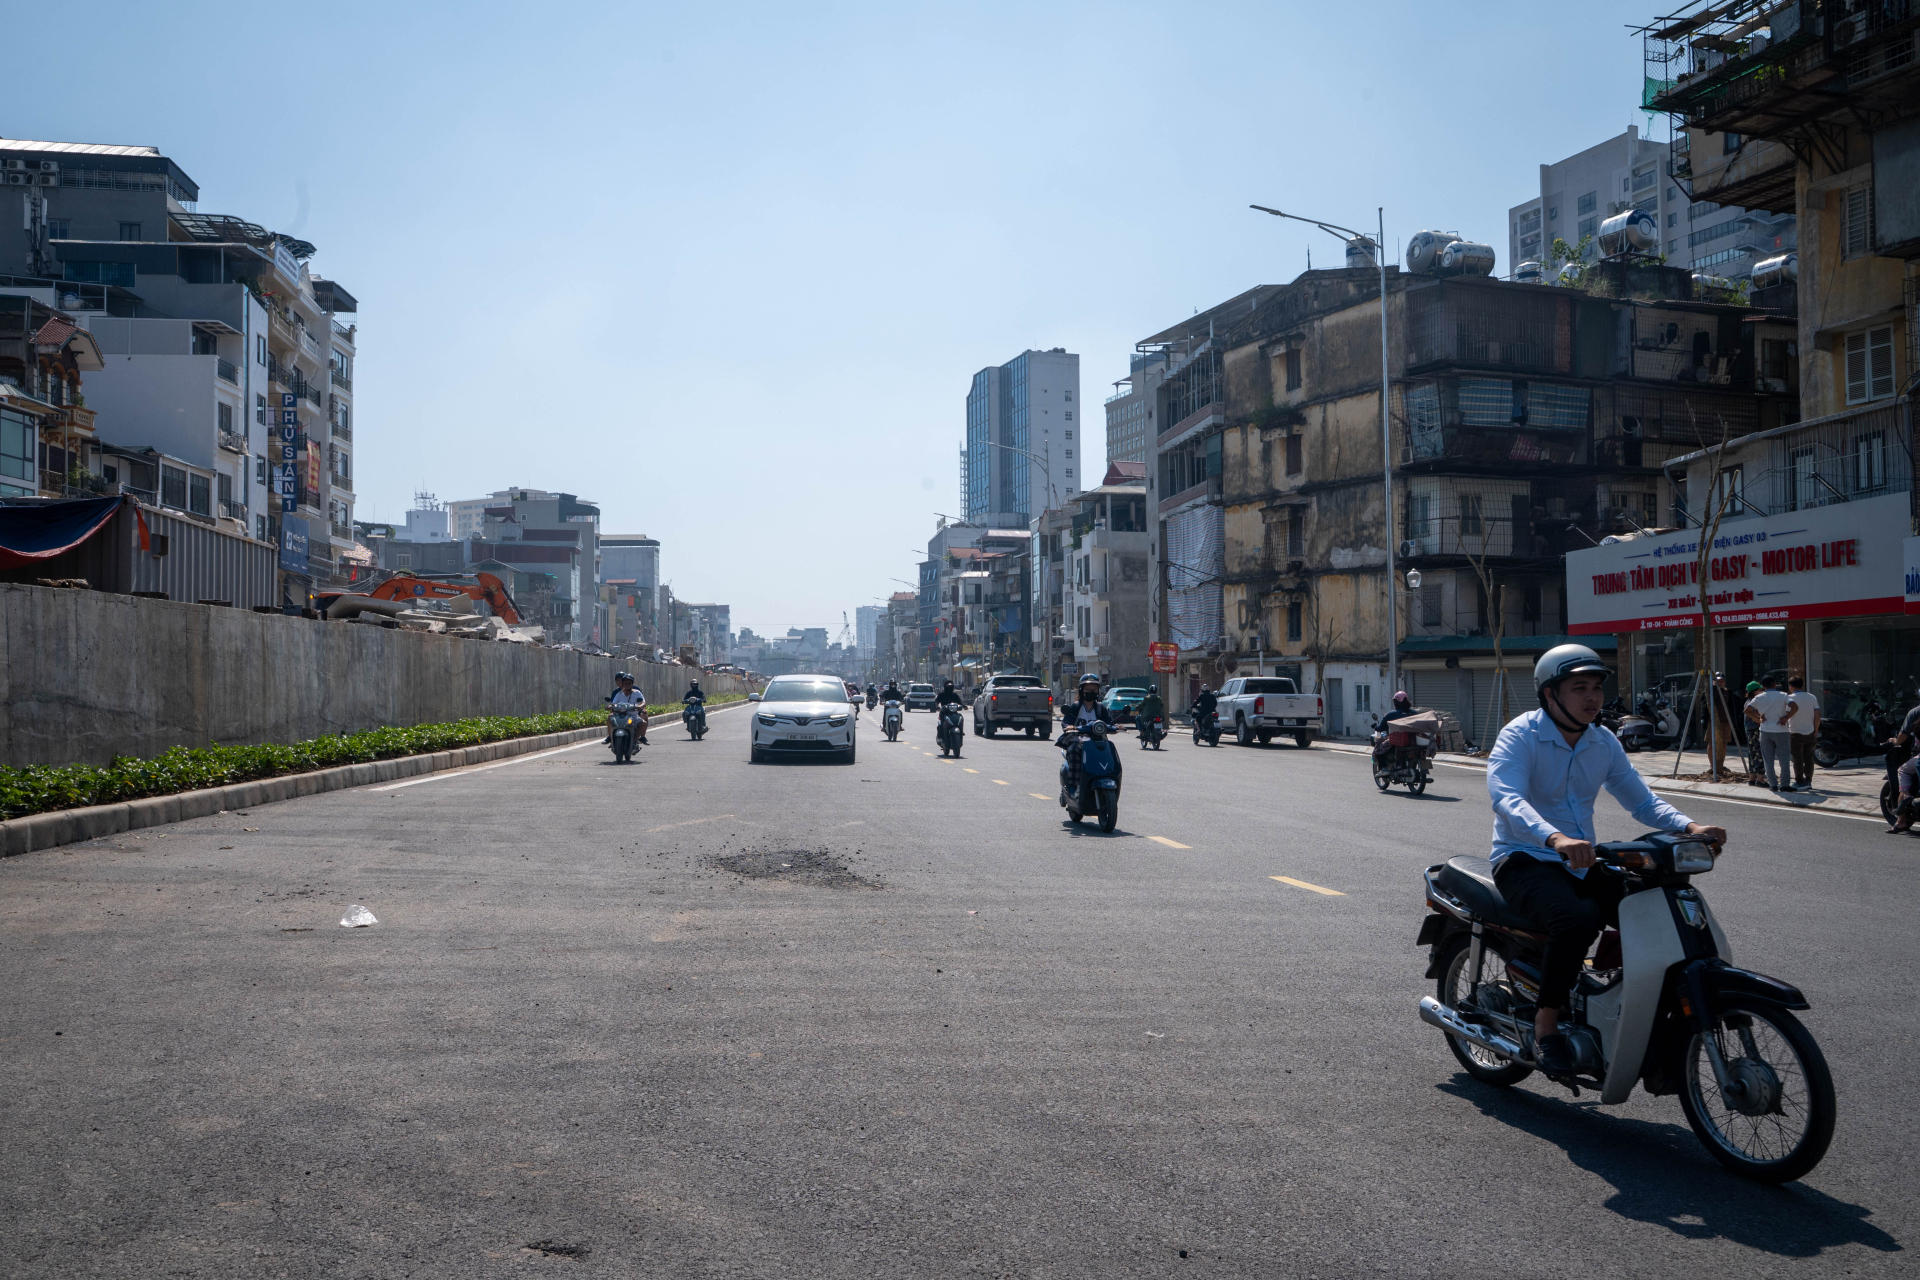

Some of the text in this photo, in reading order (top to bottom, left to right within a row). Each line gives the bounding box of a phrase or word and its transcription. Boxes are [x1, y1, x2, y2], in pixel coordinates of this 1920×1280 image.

[1653, 546, 1662, 558] HỆ
[1663, 543, 1685, 556] THỐNG
[1688, 544, 1697, 553] XE
[1714, 536, 1731, 550] ĐIỆN
[1733, 534, 1754, 546] GASY
[1756, 532, 1766, 542] 03
[1592, 571, 1627, 595] TRUNG
[1630, 564, 1654, 590] TÂM
[1658, 563, 1686, 591] DỊCH
[1712, 554, 1747, 581] GASY
[1762, 545, 1817, 575] MOTOR
[1822, 539, 1856, 568] LIFE
[1668, 599, 1678, 609] XE
